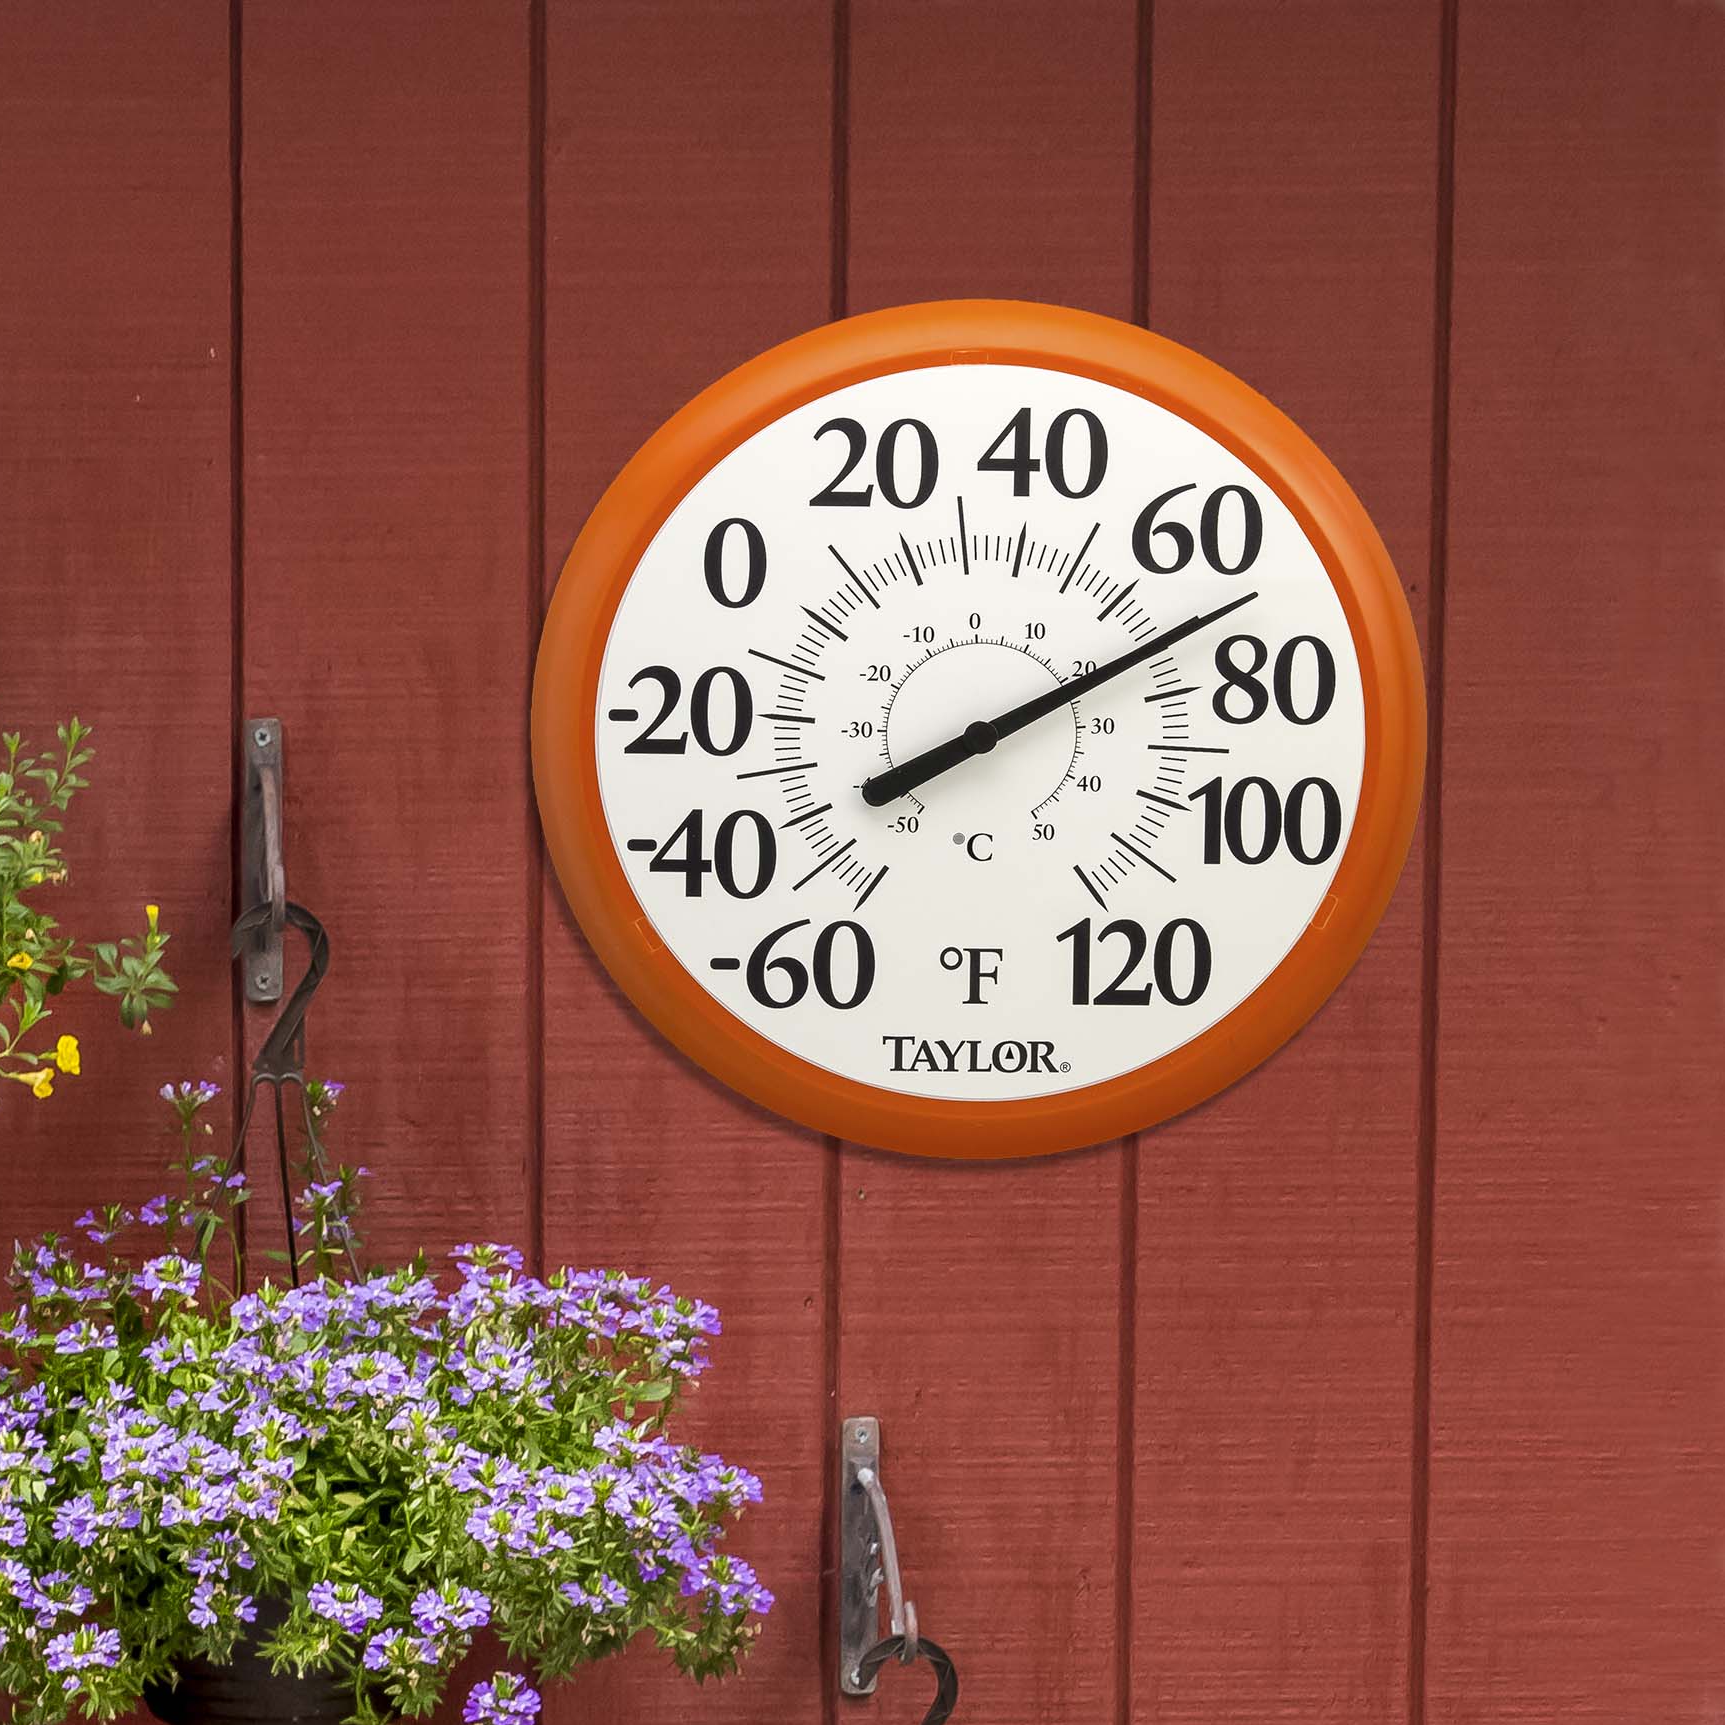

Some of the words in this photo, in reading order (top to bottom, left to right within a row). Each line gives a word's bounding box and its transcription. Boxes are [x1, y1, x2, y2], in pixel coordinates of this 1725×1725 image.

[809, 417, 939, 510] 20
[978, 407, 1109, 500] 40
[703, 517, 767, 609] 0
[1131, 482, 1265, 576] 60
[903, 626, 935, 643] -10
[969, 612, 981, 630] 0
[1025, 622, 1046, 640] 10
[859, 664, 891, 682] -20
[1212, 634, 1336, 726] 80
[608, 665, 753, 757] -20
[841, 721, 873, 739] -30
[1090, 717, 1115, 735] 30
[1076, 775, 1102, 793] 40
[1187, 775, 1342, 866] 100
[626, 808, 777, 900] -40
[887, 816, 919, 834] -50
[1032, 823, 1055, 841] 50
[709, 918, 876, 1011] -60
[939, 946, 1004, 1005] °F
[1055, 917, 1212, 1007] 120
